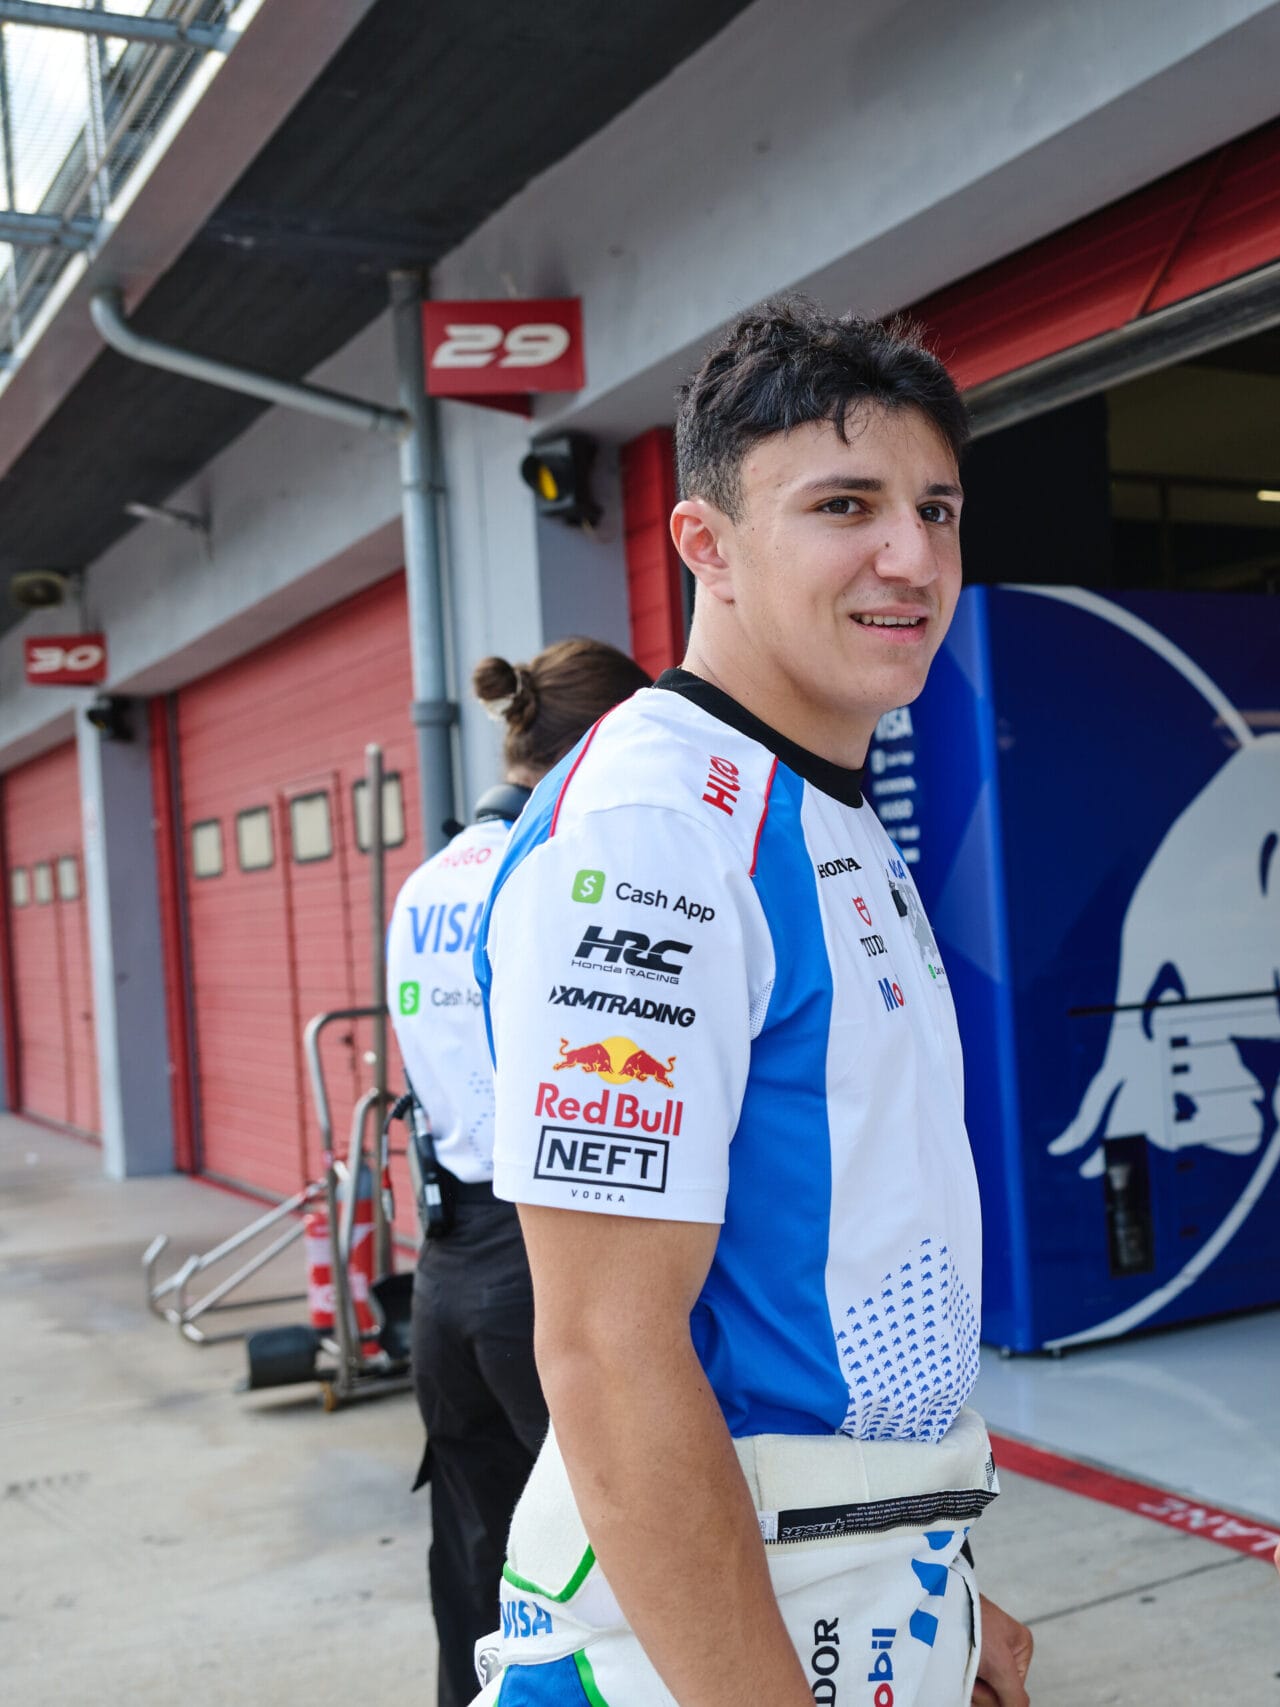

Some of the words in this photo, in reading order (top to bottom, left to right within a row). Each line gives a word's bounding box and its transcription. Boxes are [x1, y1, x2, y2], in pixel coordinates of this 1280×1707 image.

[432, 323, 570, 368] 29
[28, 645, 102, 673] 30
[615, 882, 668, 909] Cash
[672, 894, 715, 923] App
[573, 925, 694, 976] HRC
[571, 960, 623, 975] Honda
[625, 967, 681, 986] RACING
[553, 985, 697, 1028] XMTRADING
[534, 1082, 610, 1125] Red
[613, 1093, 683, 1136] Bull
[546, 1138, 658, 1180] NEFT
[571, 1189, 626, 1203] VODKA
[500, 1600, 553, 1639] VISA
